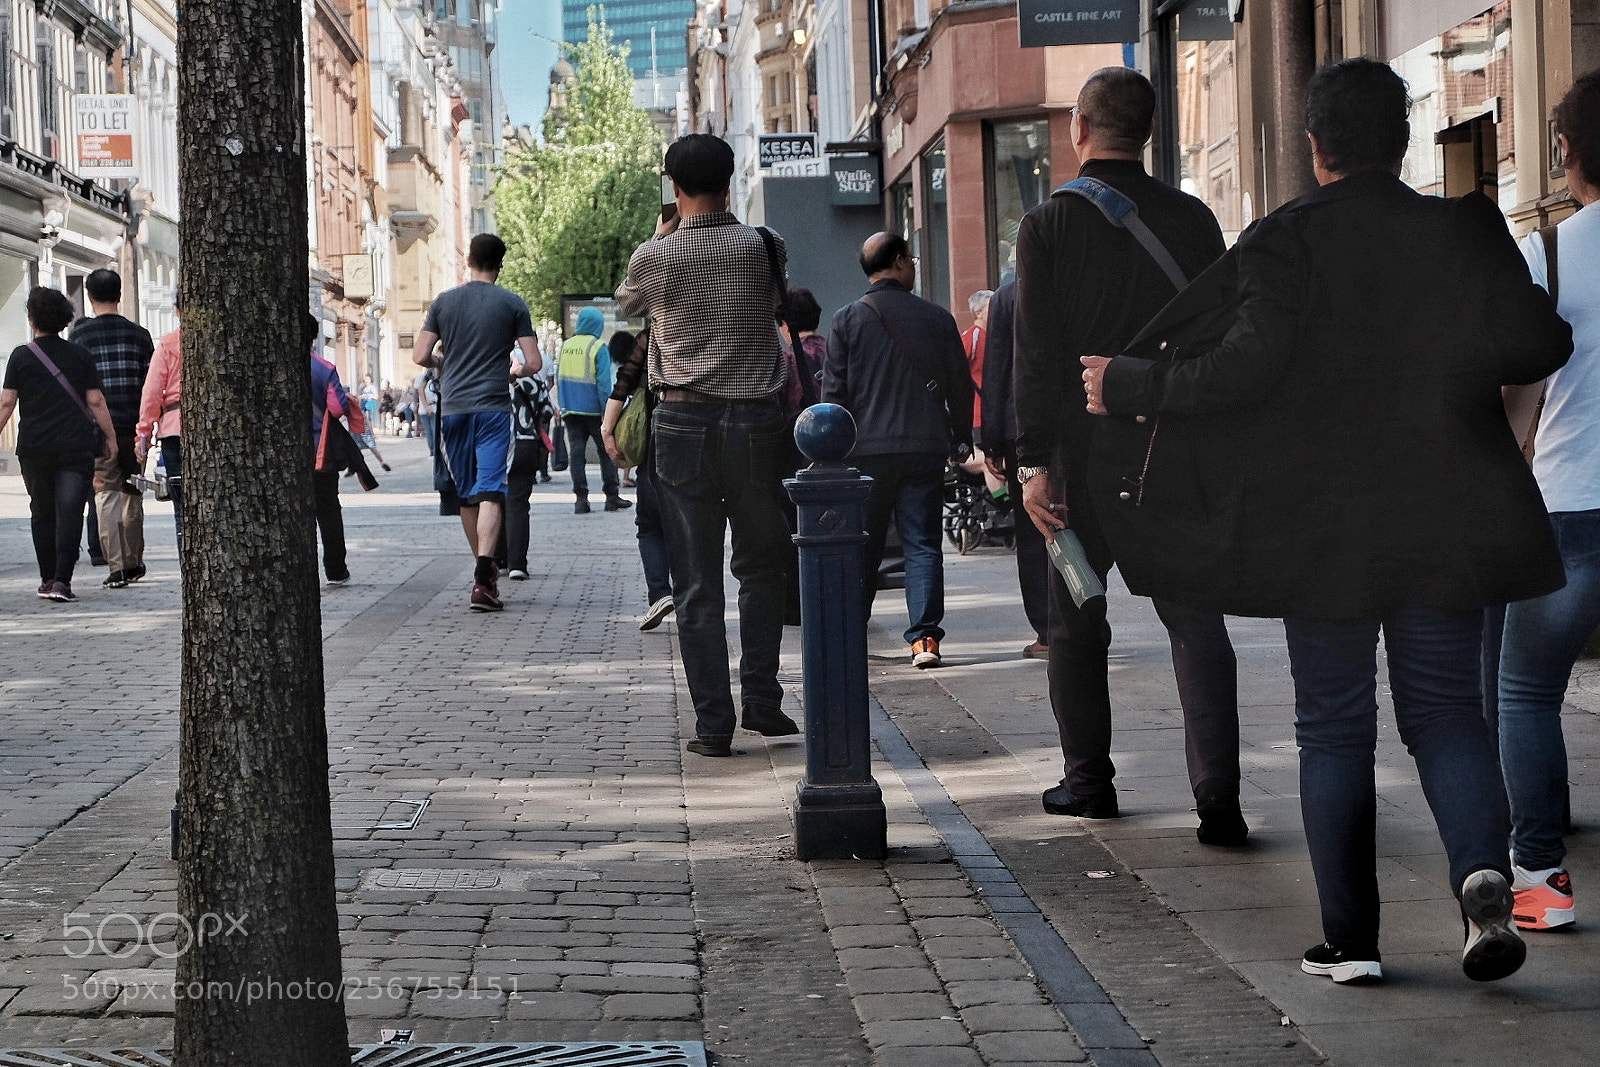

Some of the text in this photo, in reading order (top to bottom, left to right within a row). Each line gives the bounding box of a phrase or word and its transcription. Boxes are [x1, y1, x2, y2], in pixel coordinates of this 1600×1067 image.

[1034, 10, 1123, 22] CASTLE FINE ART
[79, 112, 129, 129] TO LET
[760, 141, 814, 155] KESEA
[761, 155, 783, 163] HAIR
[777, 166, 794, 176] TO
[562, 347, 583, 355] north
